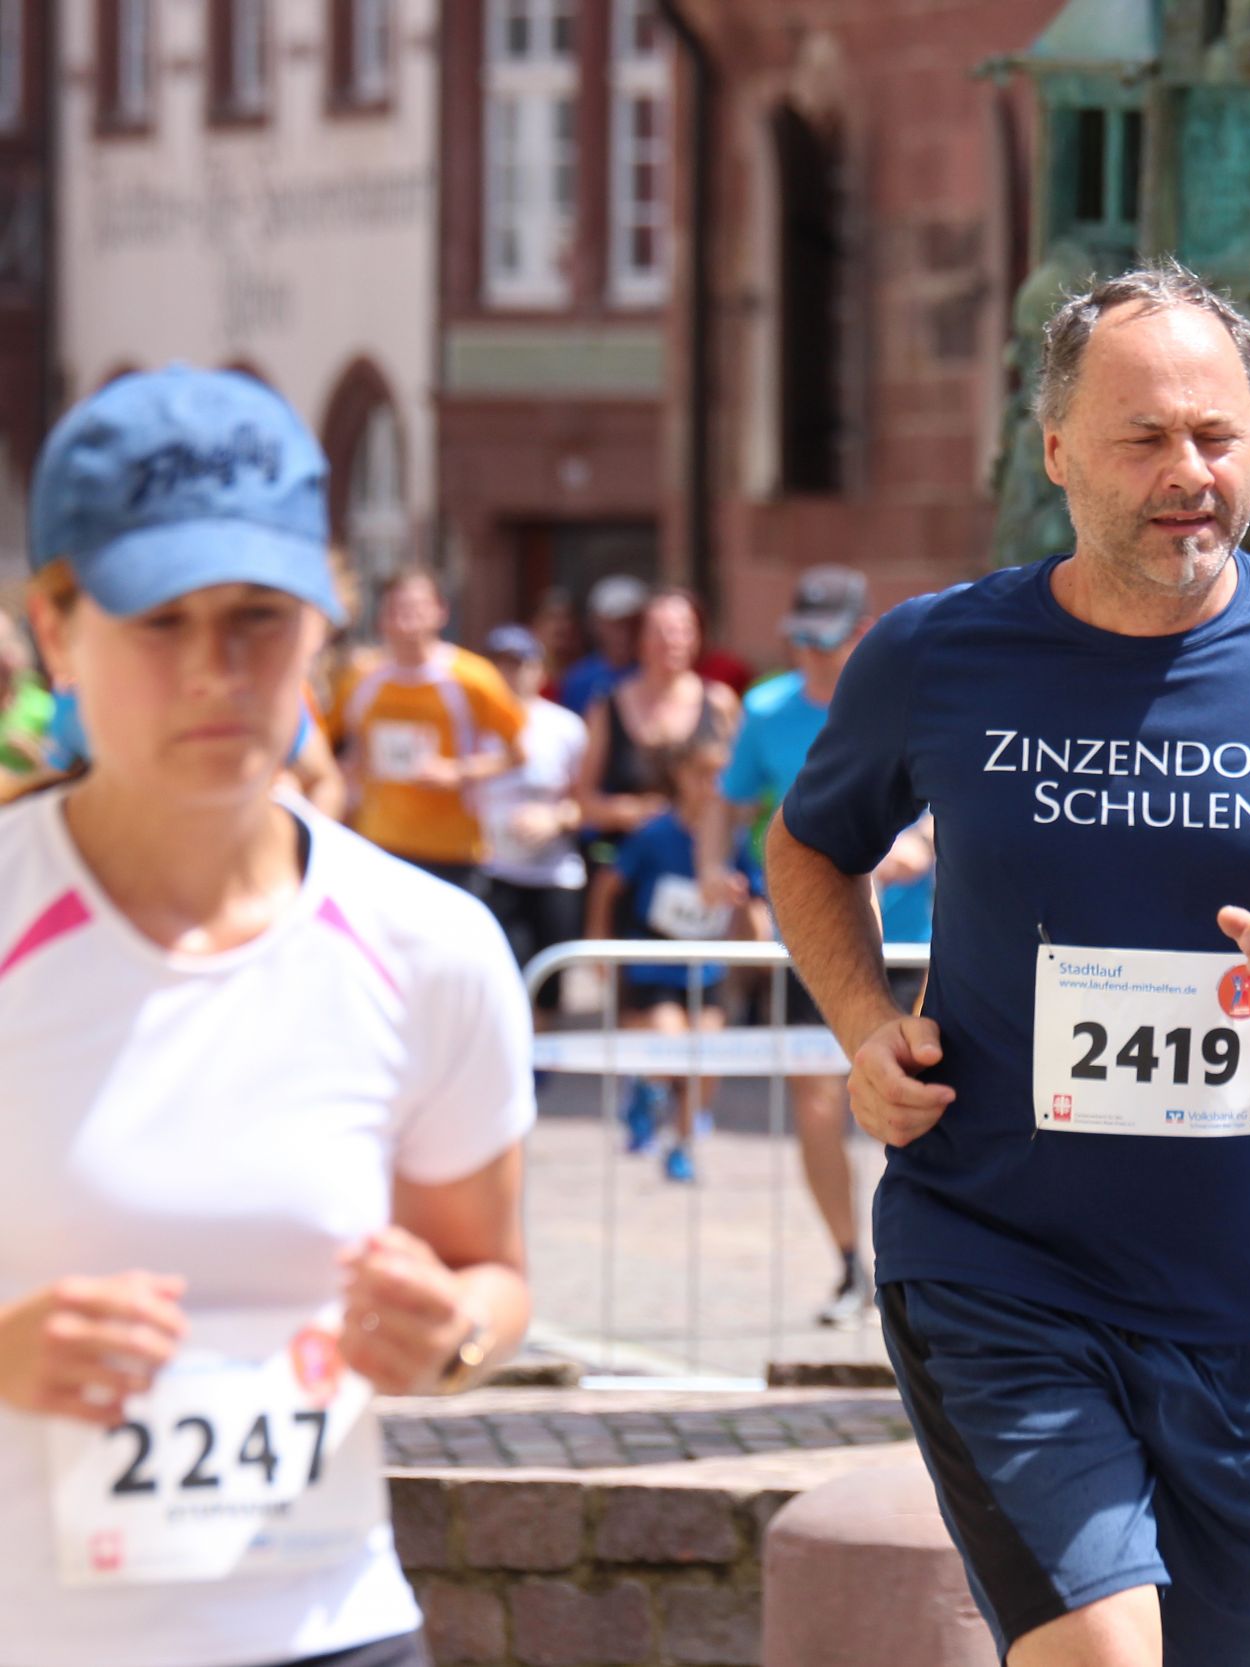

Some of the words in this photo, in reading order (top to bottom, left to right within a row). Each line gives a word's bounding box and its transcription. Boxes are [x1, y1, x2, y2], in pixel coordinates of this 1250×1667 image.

[1059, 961, 1124, 979] Stadtlauf
[1059, 978, 1197, 995] www.laufend-mithelfen.de
[1070, 1020, 1241, 1087] 2419
[107, 1411, 328, 1495] 2247
